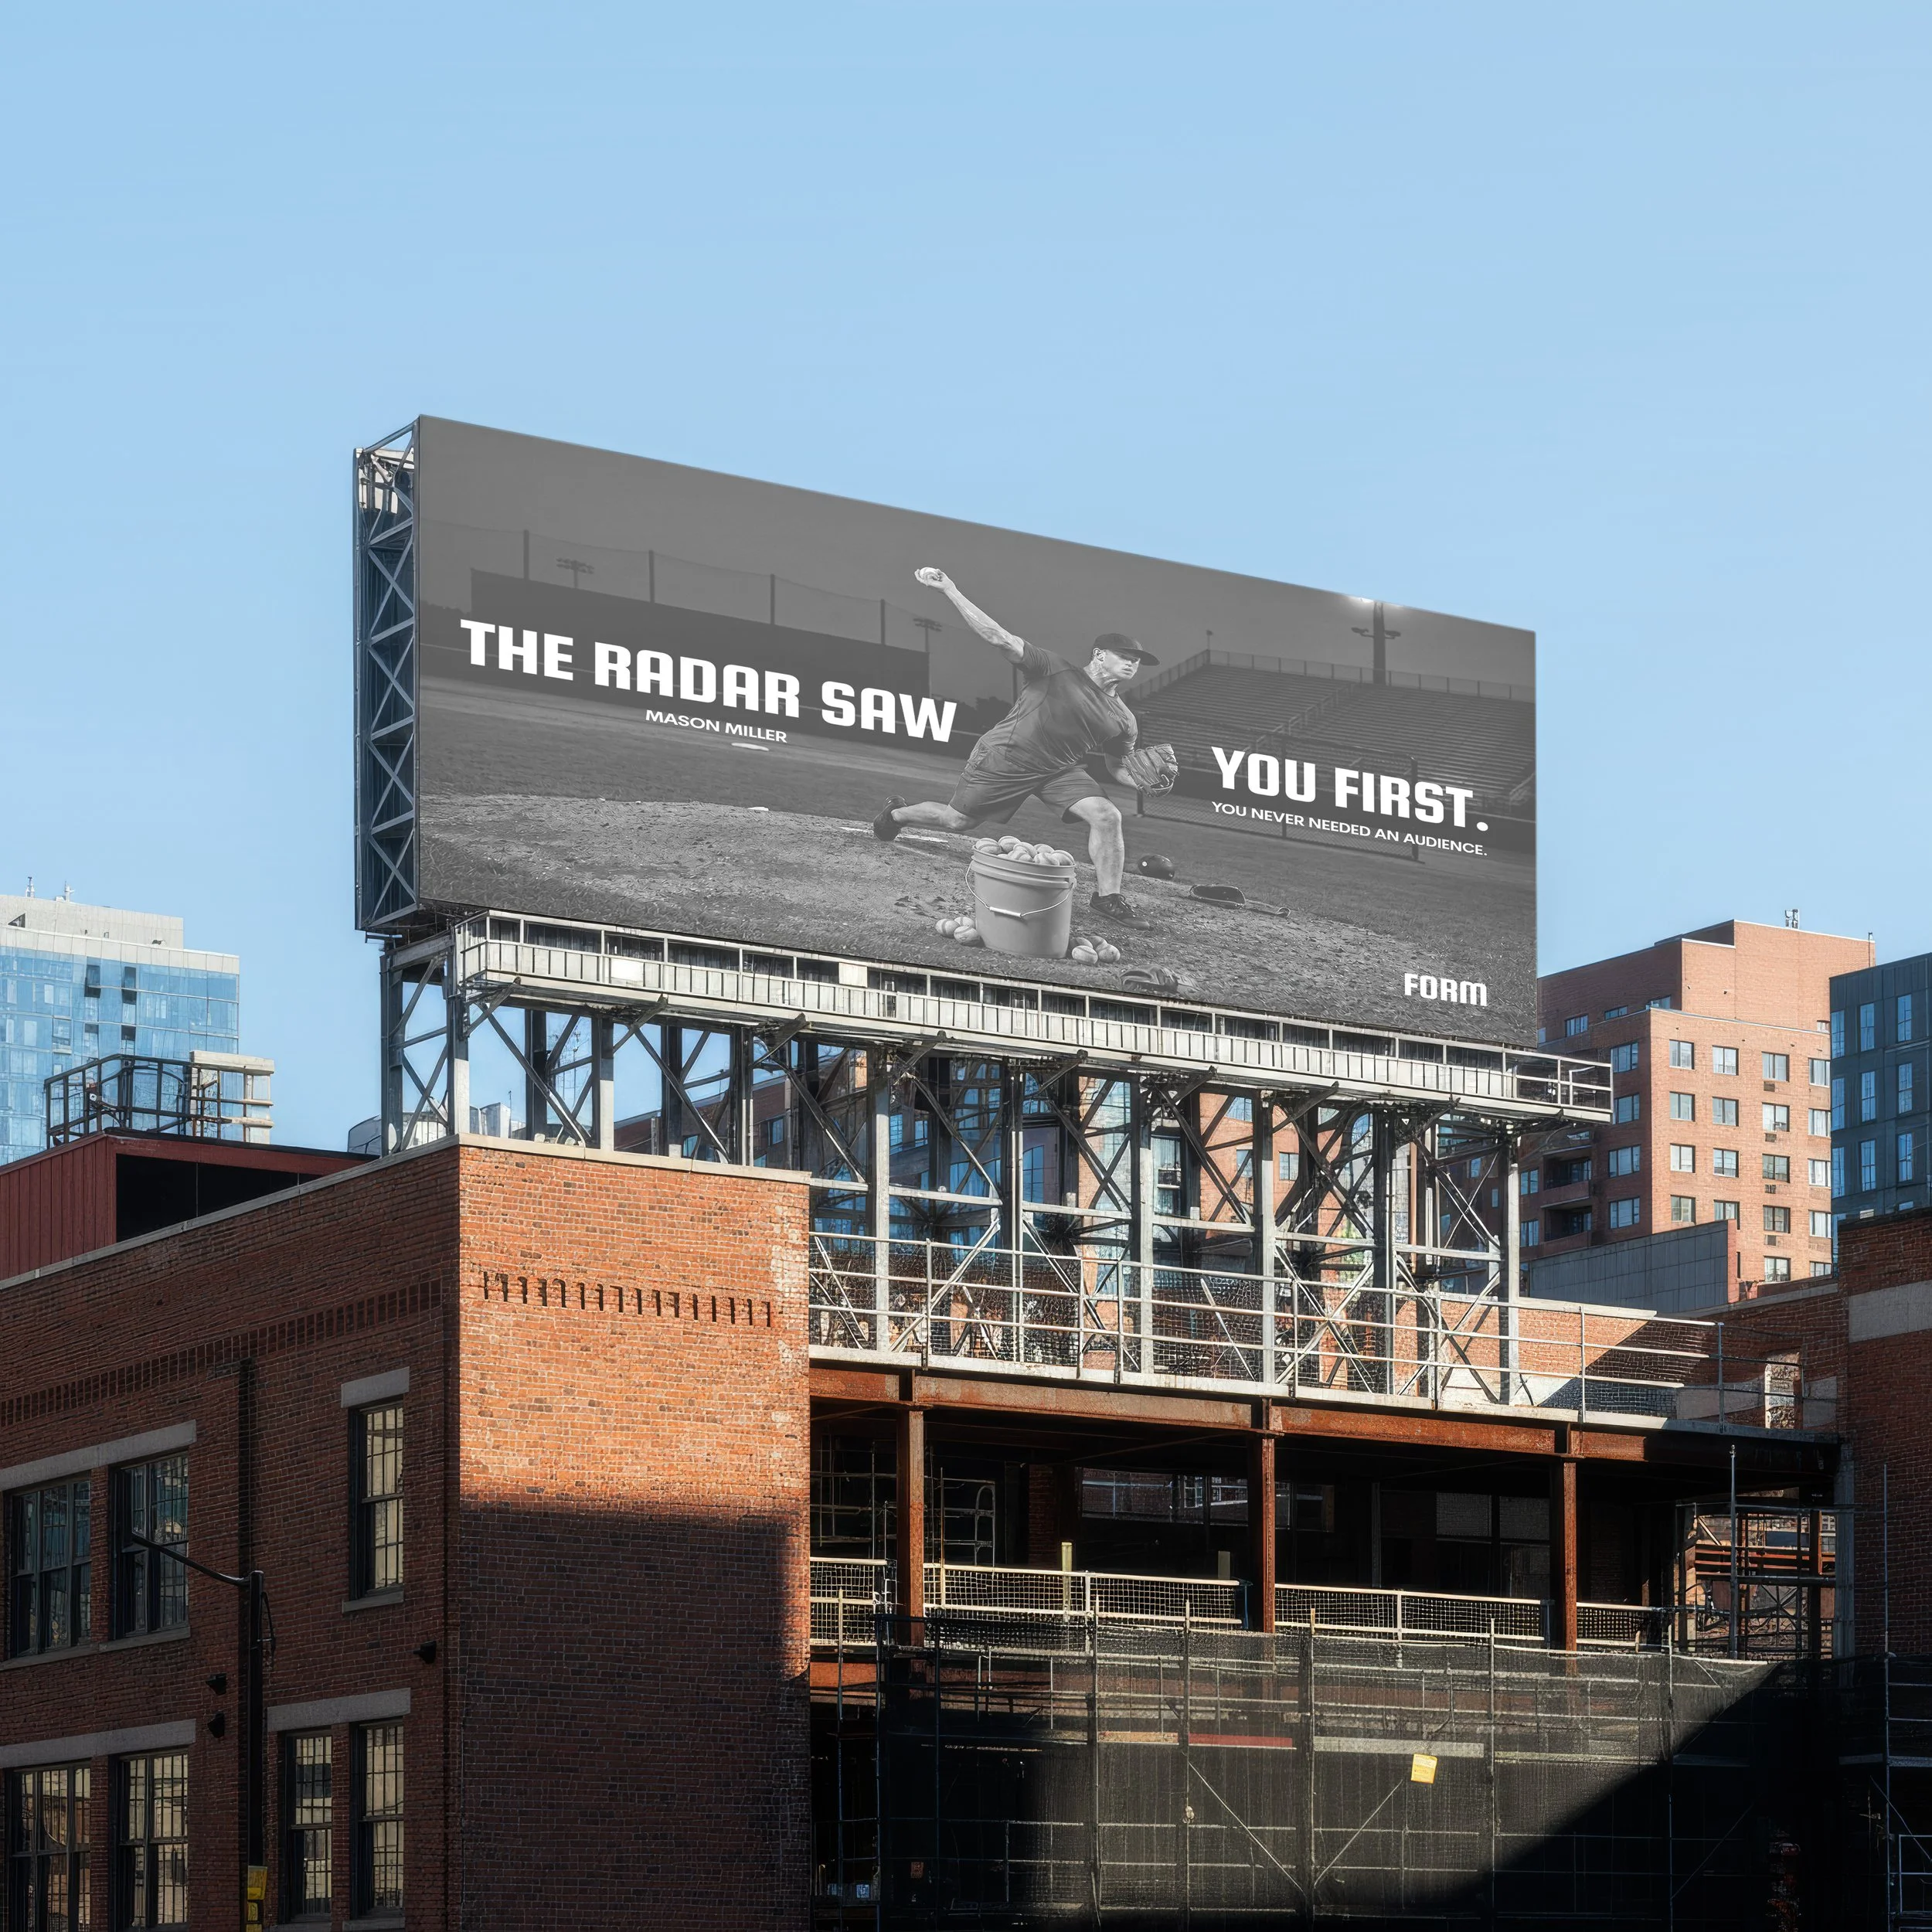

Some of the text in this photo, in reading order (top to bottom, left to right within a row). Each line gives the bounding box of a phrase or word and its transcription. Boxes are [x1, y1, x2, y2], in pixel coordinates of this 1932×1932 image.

[460, 619, 957, 743] THE RADAR SAW
[645, 709, 787, 743] MASON MILLER
[1211, 746, 1488, 832] YOU FIRST.
[1212, 801, 1488, 856] YOU NEVER NEEDED AN AUDIENCE.
